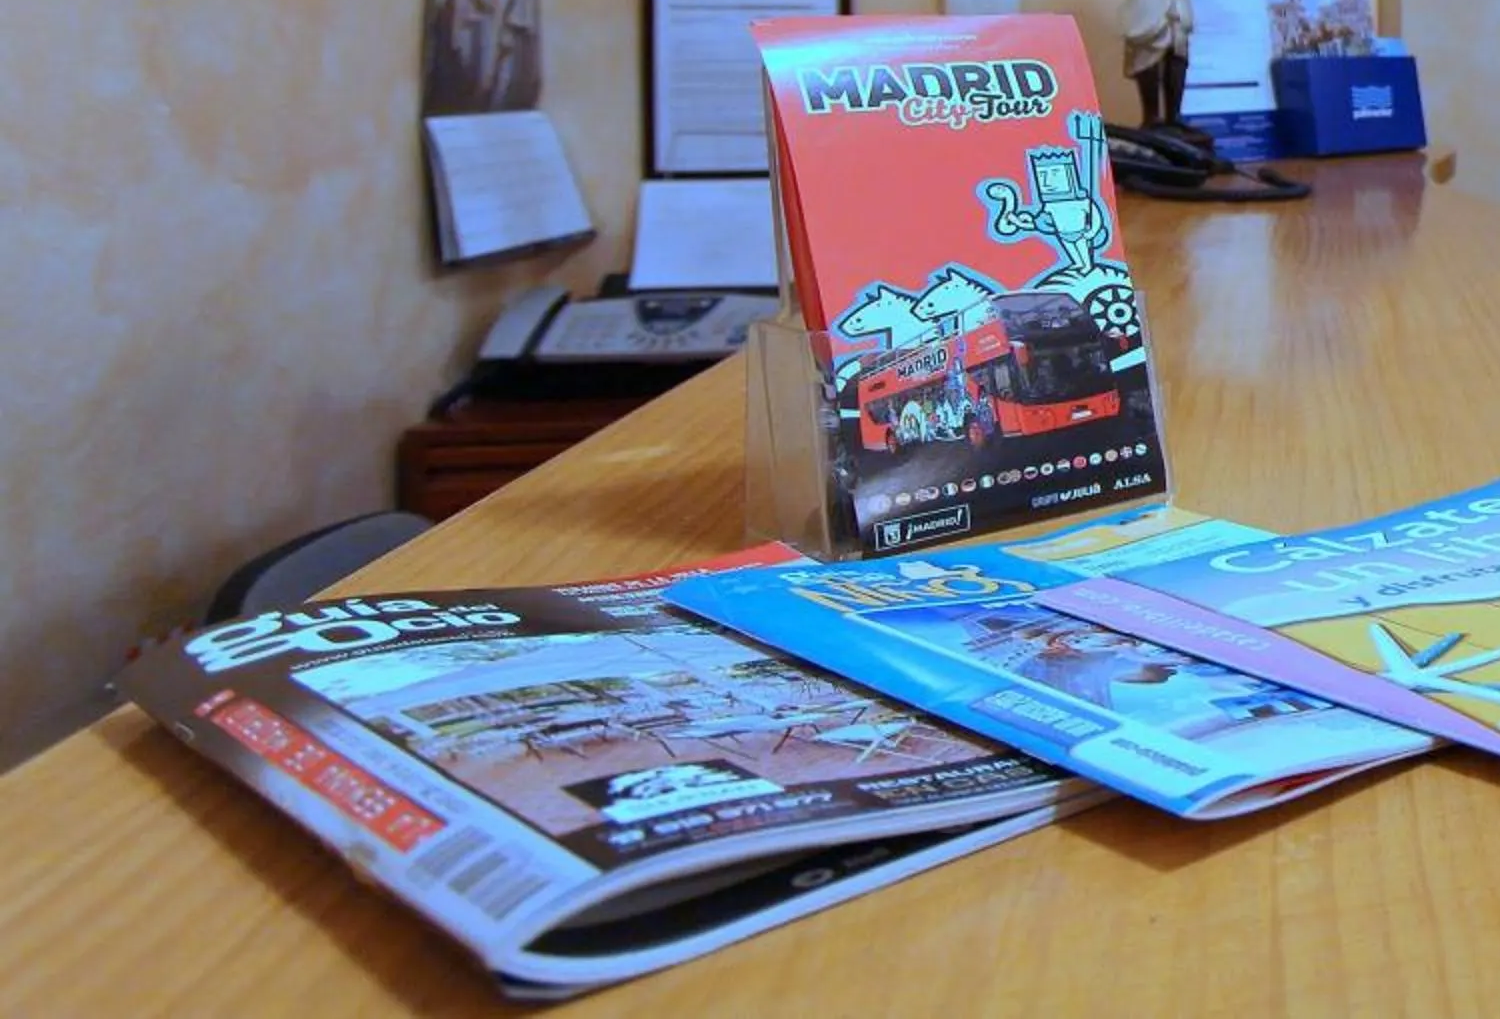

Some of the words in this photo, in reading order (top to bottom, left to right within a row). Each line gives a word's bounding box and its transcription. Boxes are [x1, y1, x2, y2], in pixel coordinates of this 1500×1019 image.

[801, 60, 1058, 111] MADRID
[903, 95, 969, 125] City
[968, 92, 1050, 120] Tour
[1113, 472, 1152, 490] ALSA
[1285, 558, 1400, 593] un
[1336, 593, 1372, 608] y
